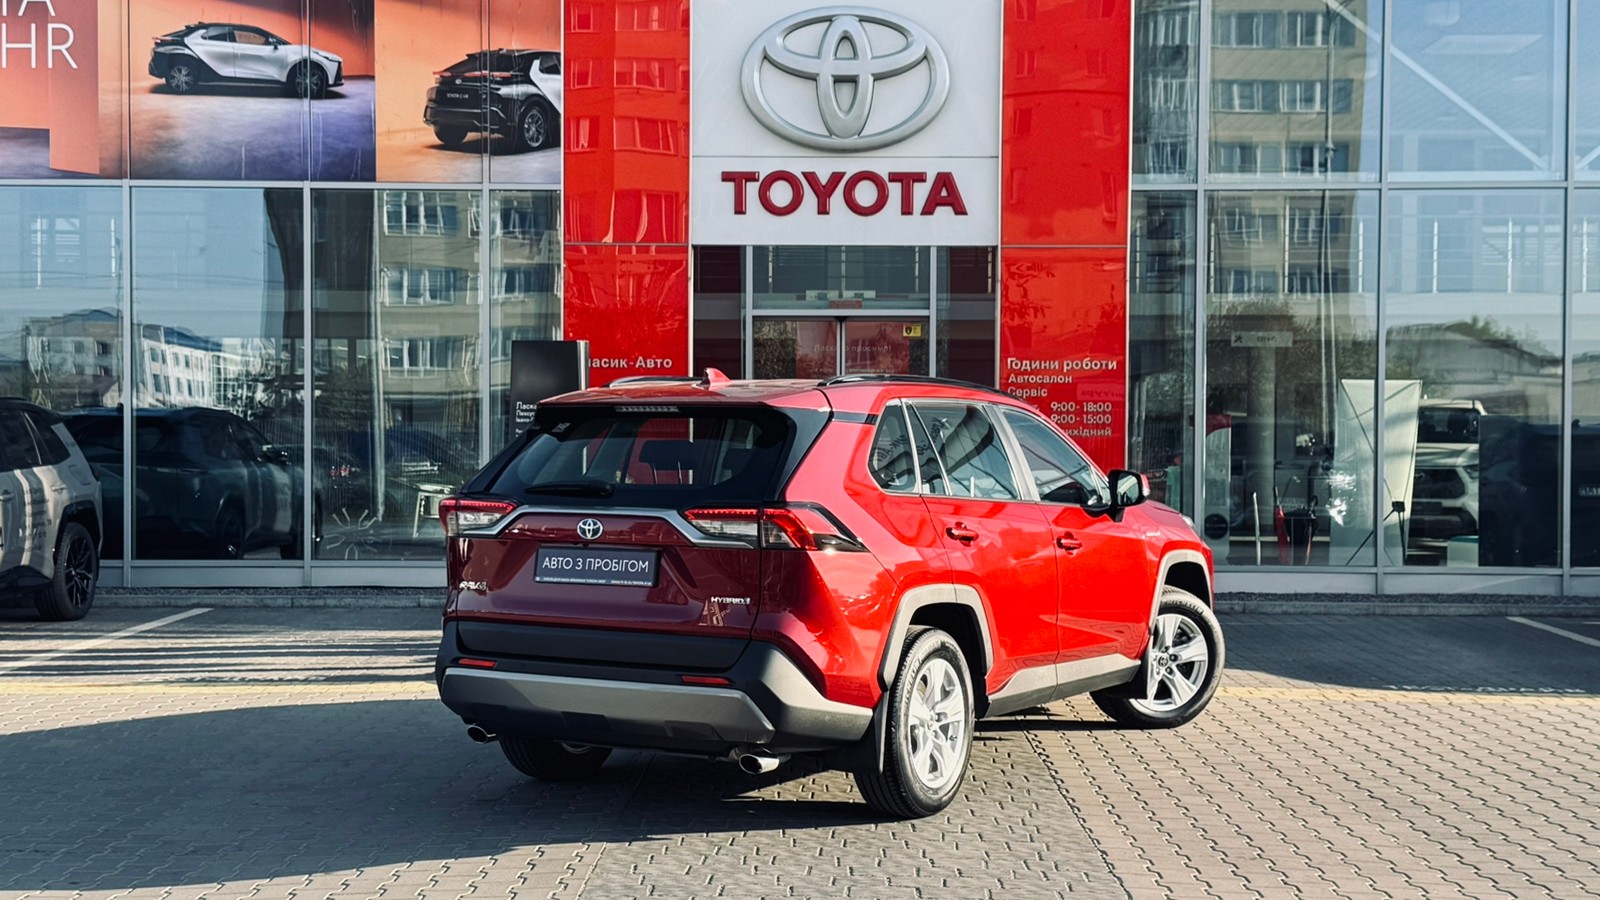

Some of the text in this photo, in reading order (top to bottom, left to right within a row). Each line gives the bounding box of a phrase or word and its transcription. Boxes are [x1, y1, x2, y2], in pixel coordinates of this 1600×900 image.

[721, 170, 968, 217] TOYOTA
[1007, 357, 1117, 373] Години роботи
[1008, 373, 1073, 384] Автосалон
[1007, 386, 1048, 398] Сервіс
[516, 401, 537, 410] Ласка
[1063, 426, 1112, 437] ихідний
[542, 557, 573, 570] АВТО
[585, 558, 649, 573] ПРОБІГОМ
